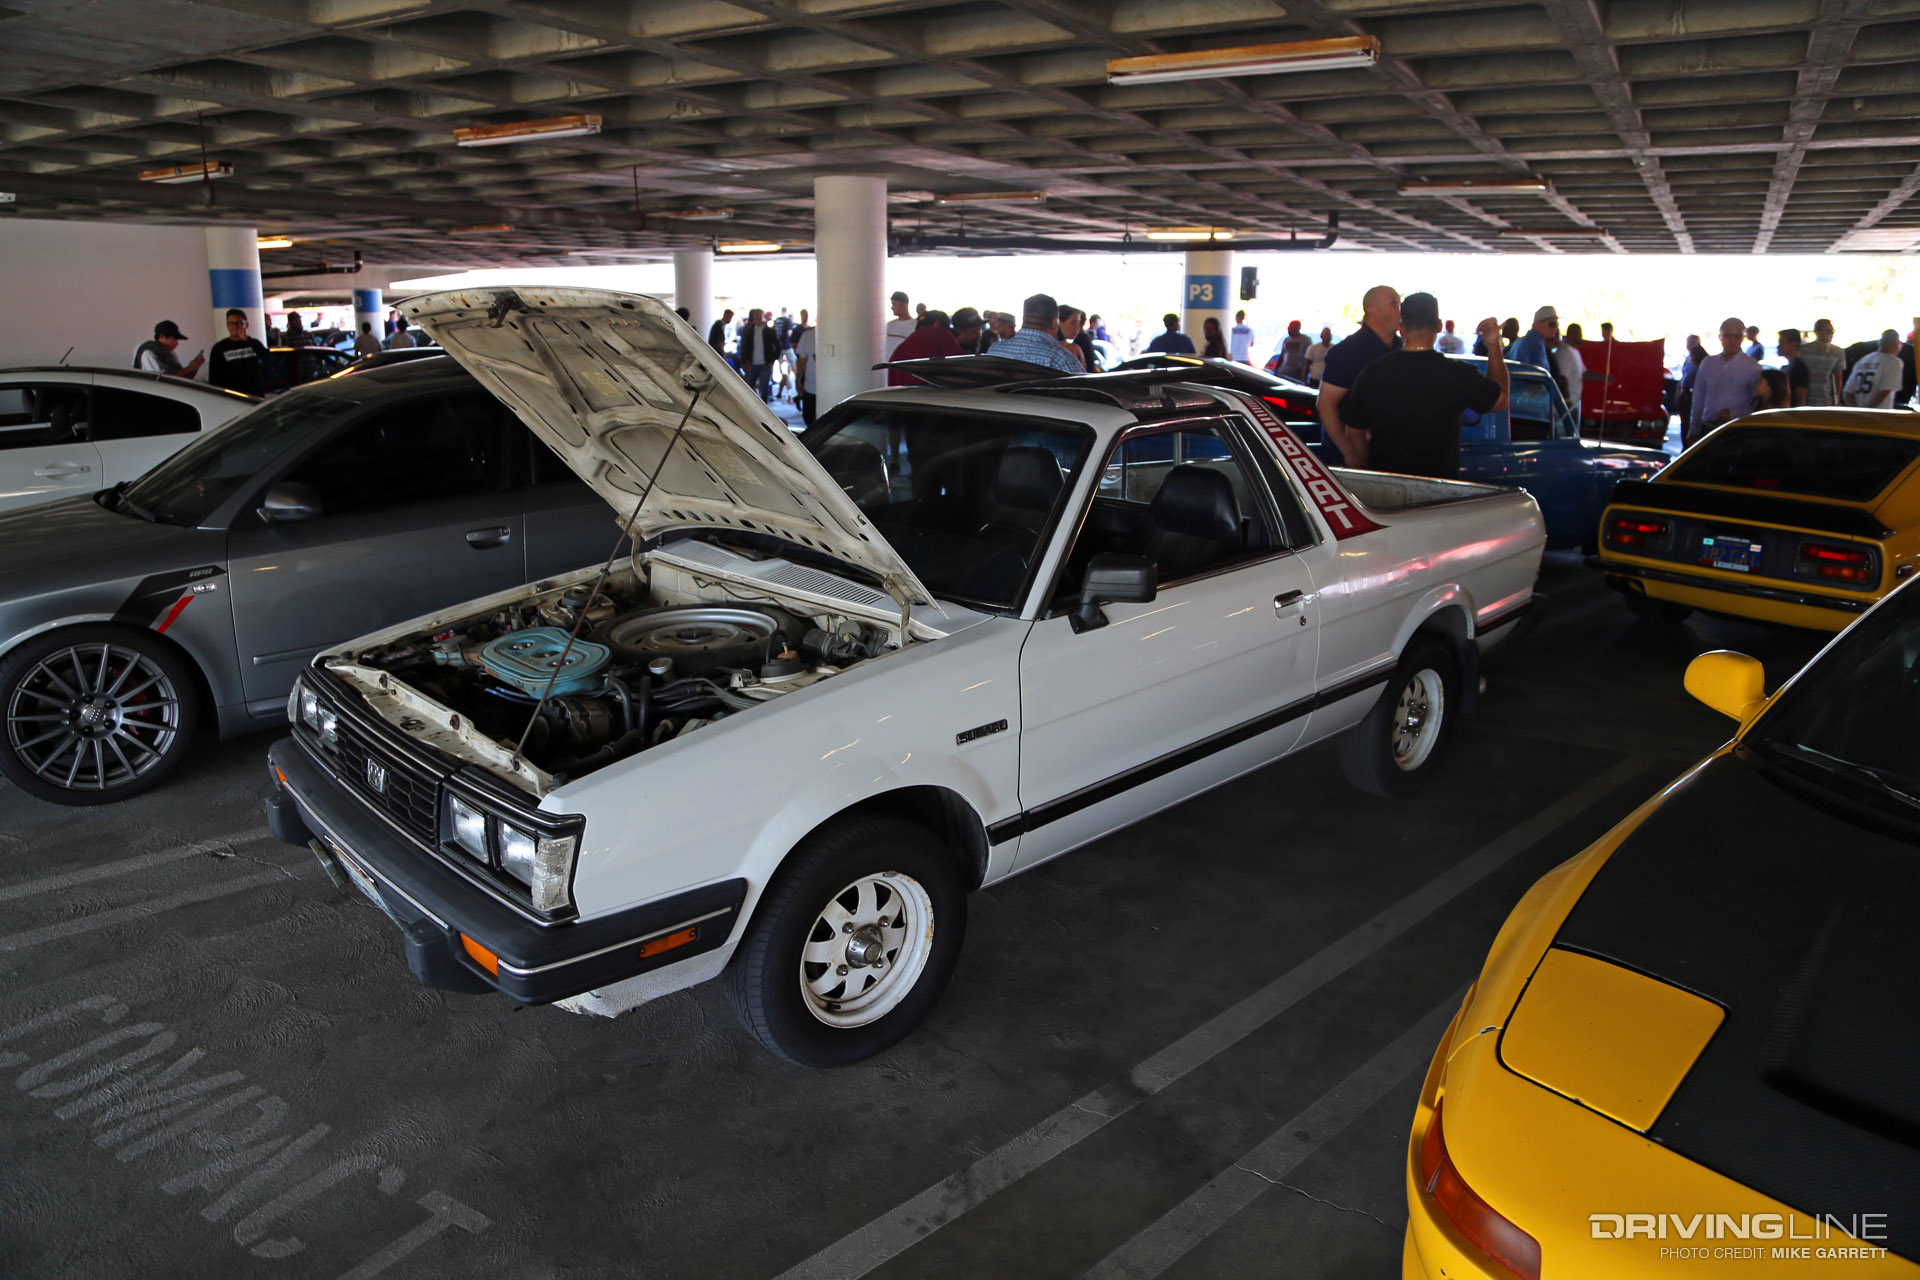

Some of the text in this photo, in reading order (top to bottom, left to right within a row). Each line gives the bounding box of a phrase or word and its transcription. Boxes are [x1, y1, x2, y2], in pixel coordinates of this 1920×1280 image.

[1190, 283, 1213, 301] P3
[1275, 436, 1353, 529] BRAT
[957, 720, 1007, 745] SUBARU
[0, 995, 491, 1280] COMPACT
